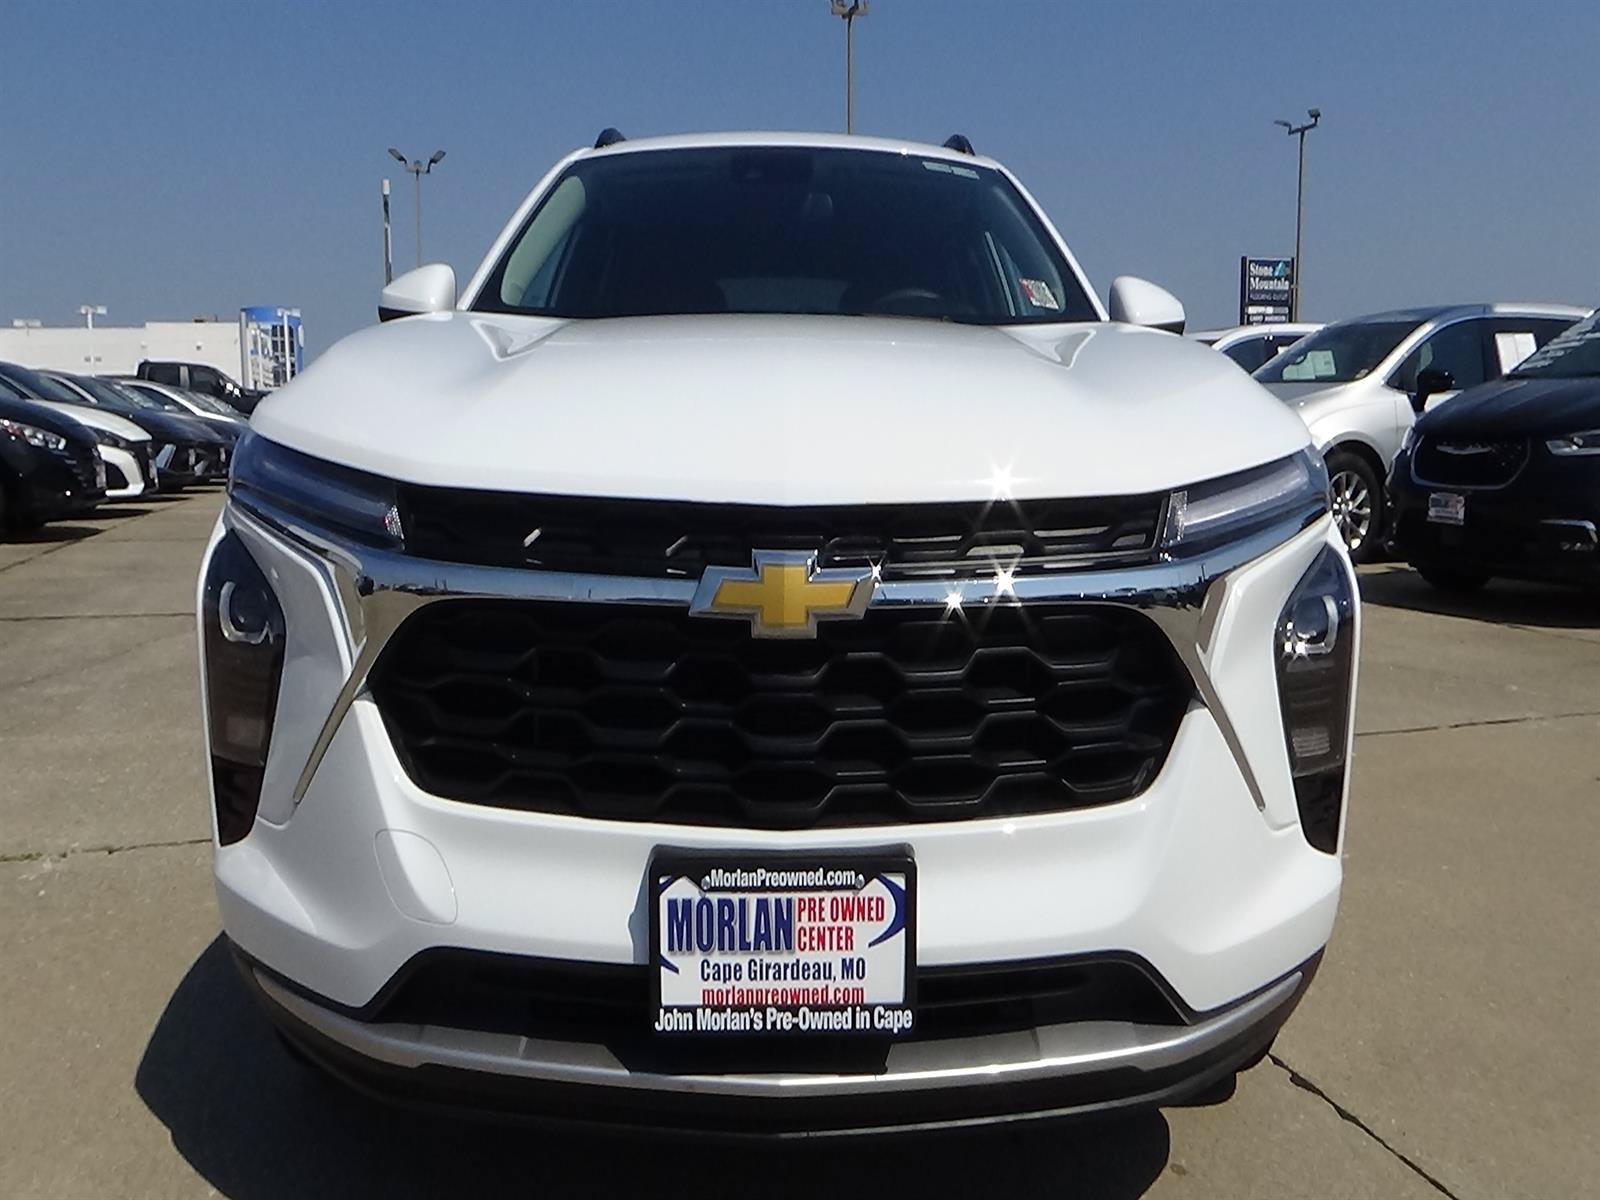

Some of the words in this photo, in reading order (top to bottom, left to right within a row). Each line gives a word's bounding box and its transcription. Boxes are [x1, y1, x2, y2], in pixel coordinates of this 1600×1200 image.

[1250, 277, 1289, 290] Mountain
[710, 868, 857, 890] MorlanPreowned.com
[667, 897, 794, 953] MORLAN
[798, 897, 825, 922] PRE
[831, 896, 885, 922] OWNED
[797, 926, 854, 952] CENTER
[701, 959, 742, 984] Cape
[748, 958, 837, 983] Girardeau,
[841, 958, 866, 980] MO
[702, 985, 865, 1005] morlanpreowned.com
[655, 1008, 693, 1031] John
[697, 1008, 763, 1031] Morlan's
[766, 1007, 852, 1031] Pre-Owned
[856, 1007, 870, 1029] in
[874, 1006, 913, 1033] Cape
